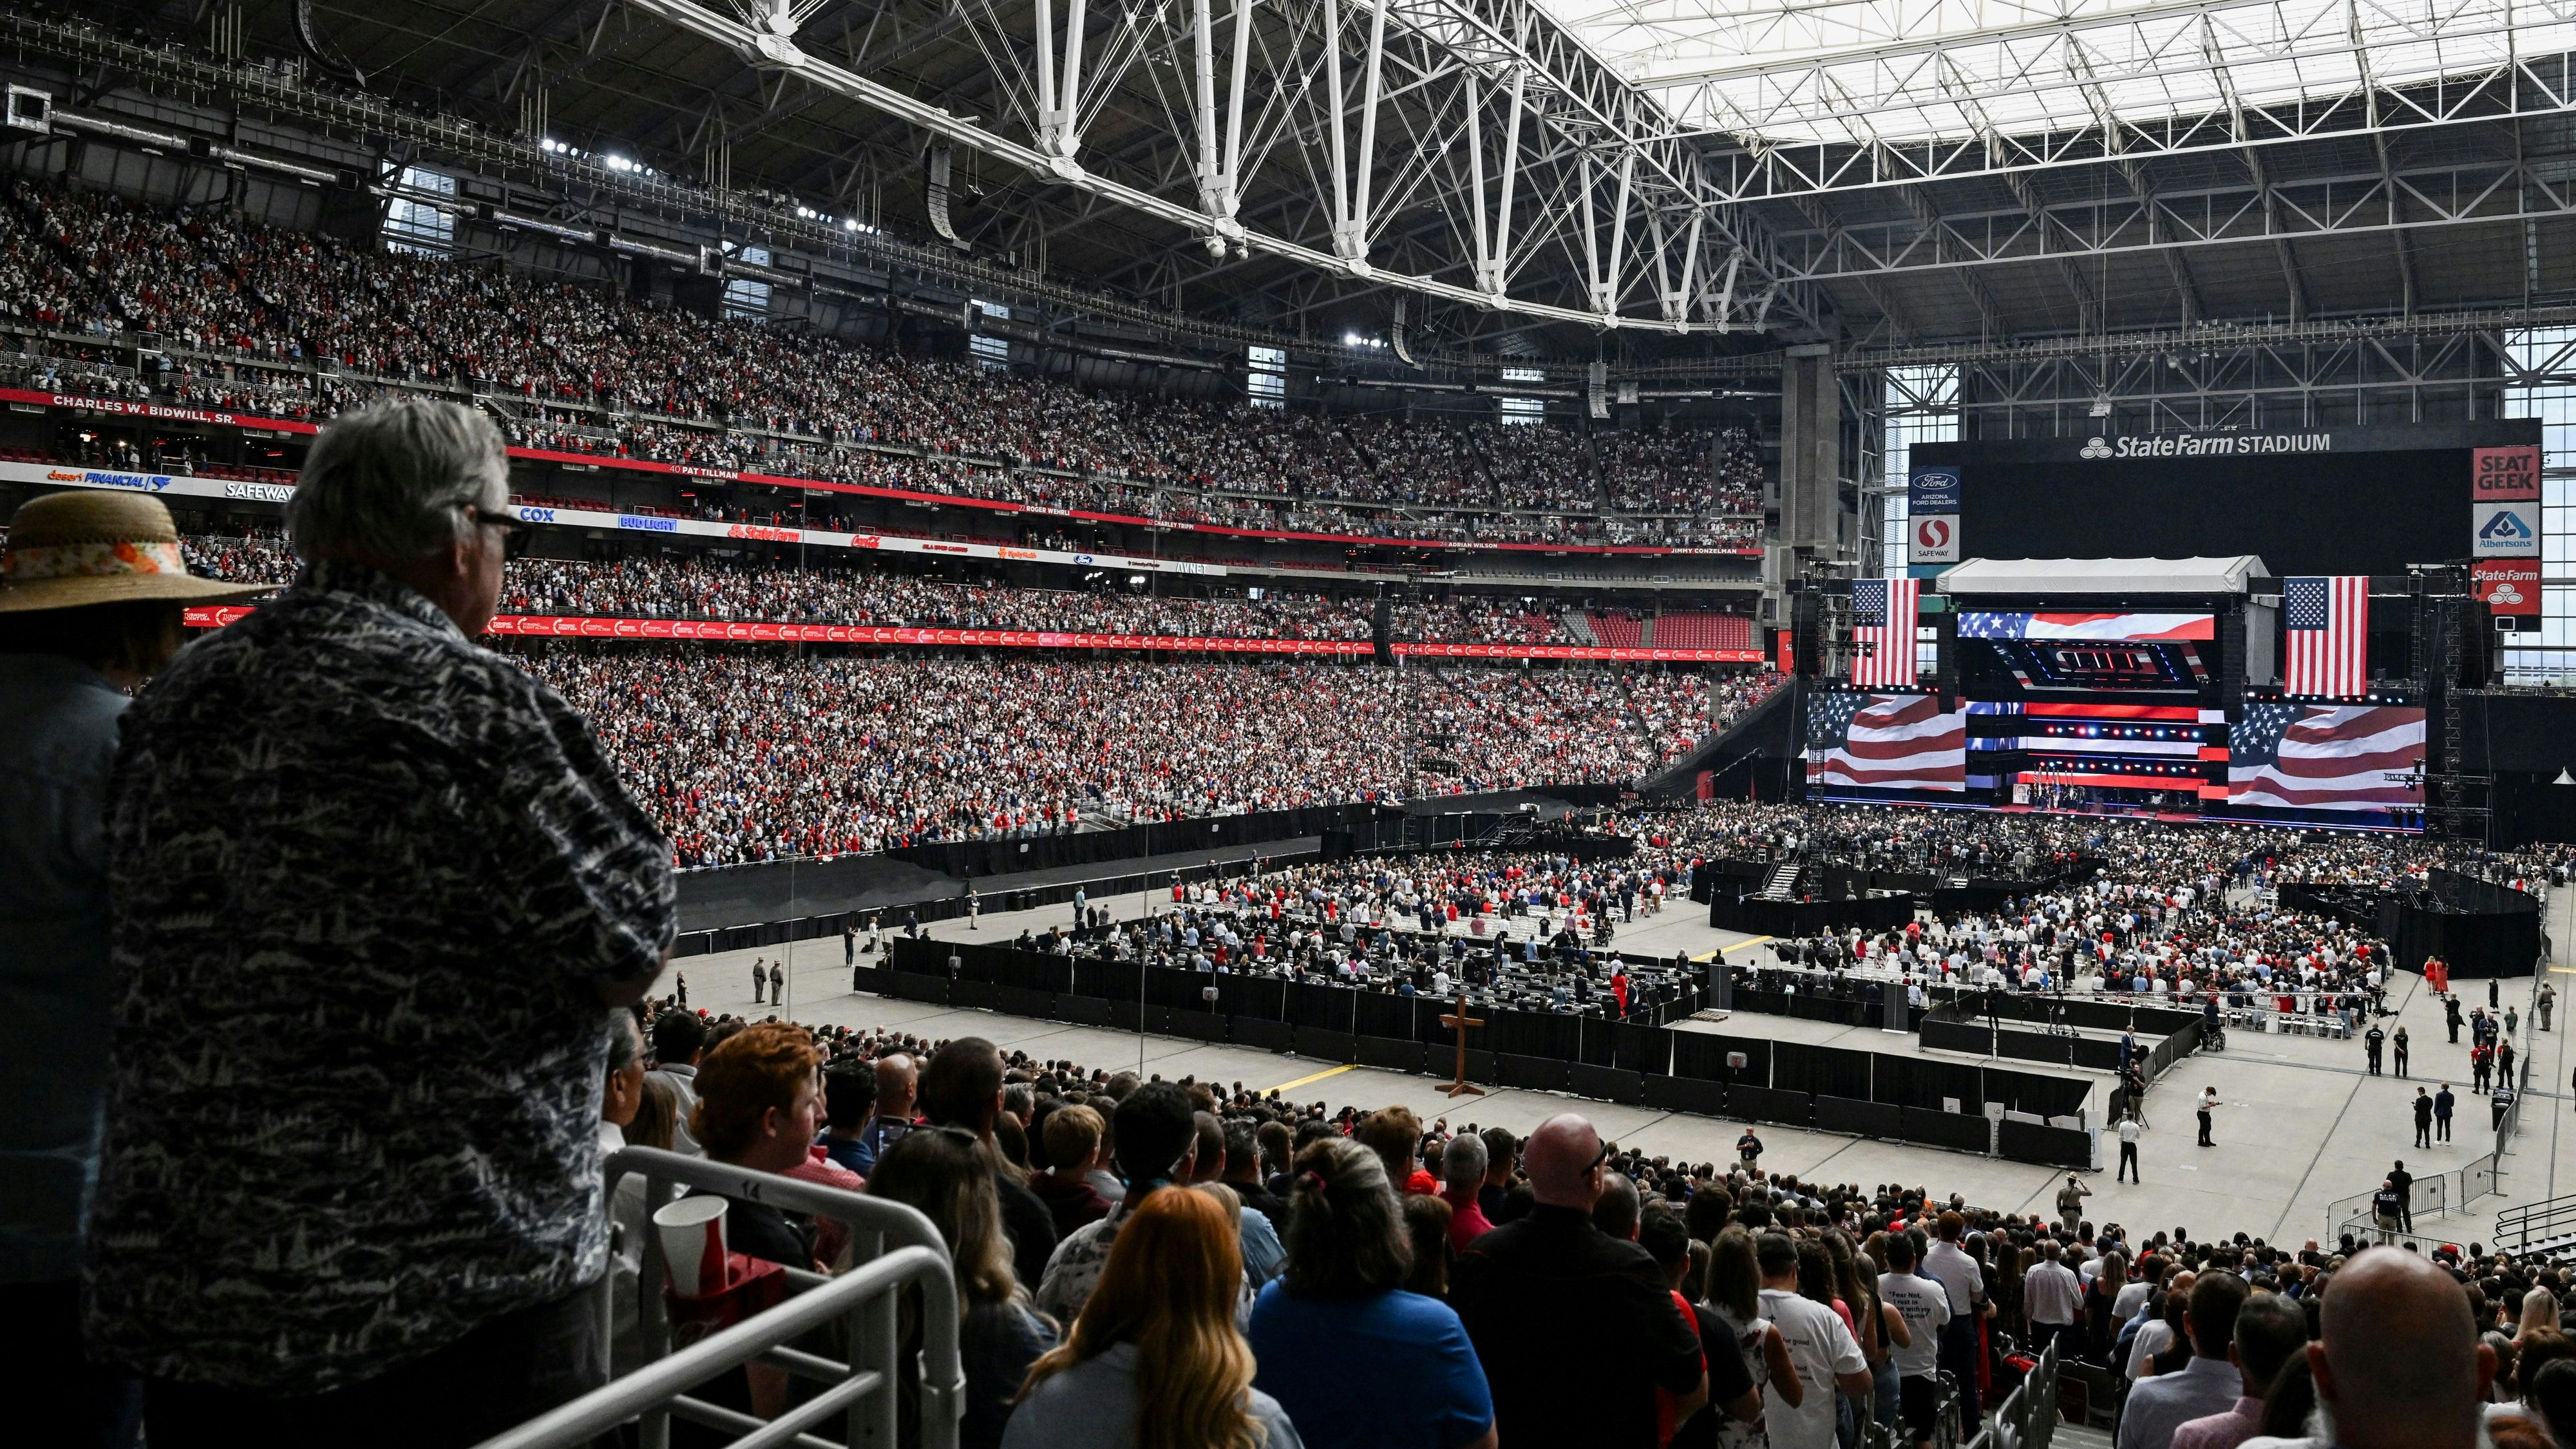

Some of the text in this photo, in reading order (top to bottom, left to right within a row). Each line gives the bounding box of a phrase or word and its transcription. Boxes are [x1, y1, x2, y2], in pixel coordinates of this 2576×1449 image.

[53, 395, 236, 424] CHARLES W. BIDWILL, SR.
[2237, 434, 2330, 453] STADIUM
[2481, 454, 2532, 472] SEAT
[48, 470, 145, 488] desert FINANCIAL
[669, 465, 738, 479] 40 PAT TILLMAN
[1921, 475, 1949, 488] Ford
[2477, 472, 2534, 490] GEEK
[225, 483, 296, 500] SAFEWAY
[520, 507, 554, 522] COX
[1027, 505, 1047, 513] ROGER
[1048, 507, 1070, 516] WEHRLI
[621, 517, 676, 531] BUD LIGHT
[2479, 539, 2532, 548] Albertsons
[1176, 562, 1208, 575] AVNET
